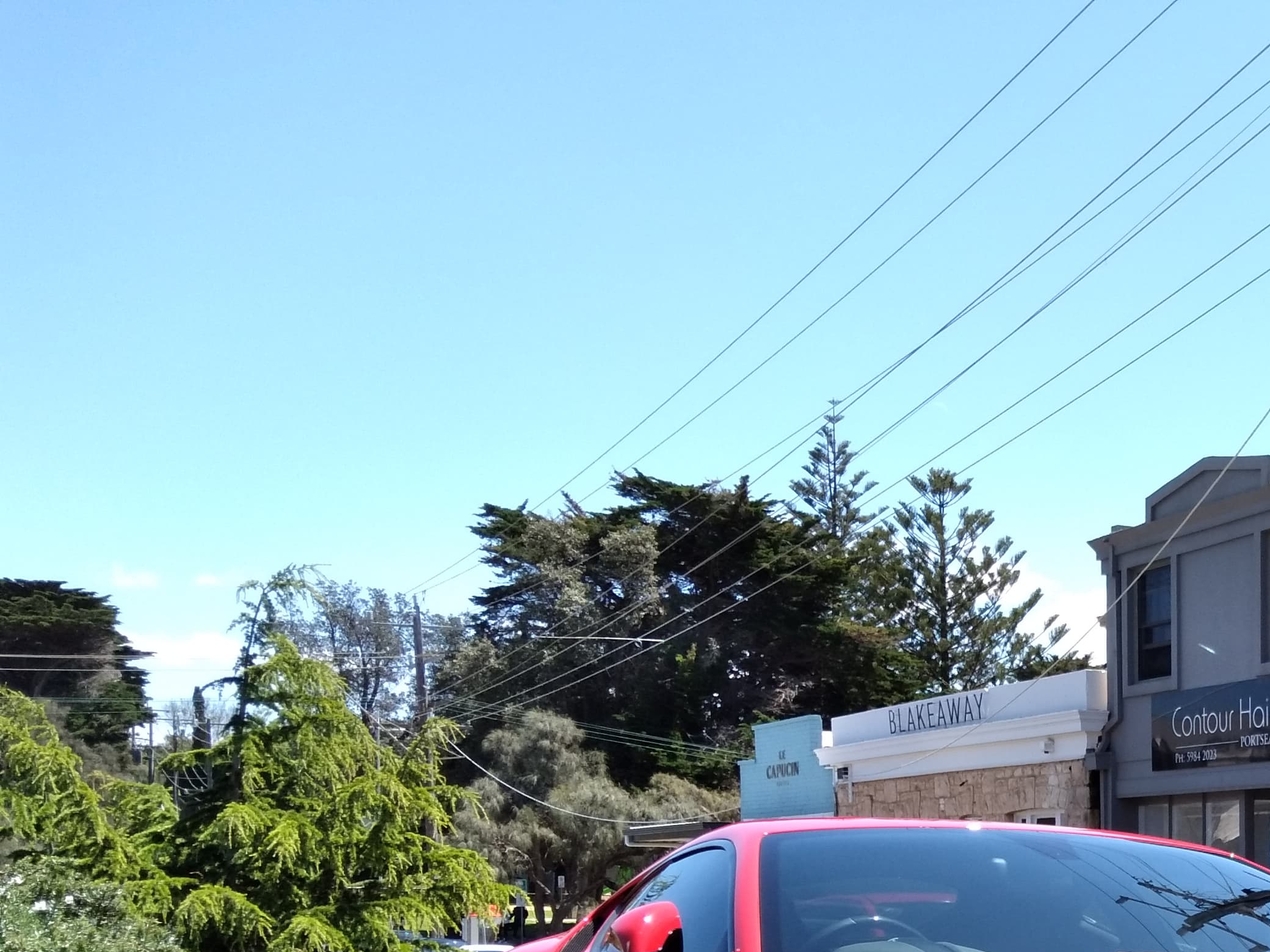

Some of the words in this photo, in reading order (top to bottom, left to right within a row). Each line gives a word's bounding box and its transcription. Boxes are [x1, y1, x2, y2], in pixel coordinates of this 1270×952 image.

[888, 693, 983, 735] BLAKEAWAY
[1172, 706, 1235, 737] Contour
[778, 750, 786, 760] LE
[1202, 749, 1217, 760] 2023
[766, 761, 800, 779] CAPUCIN
